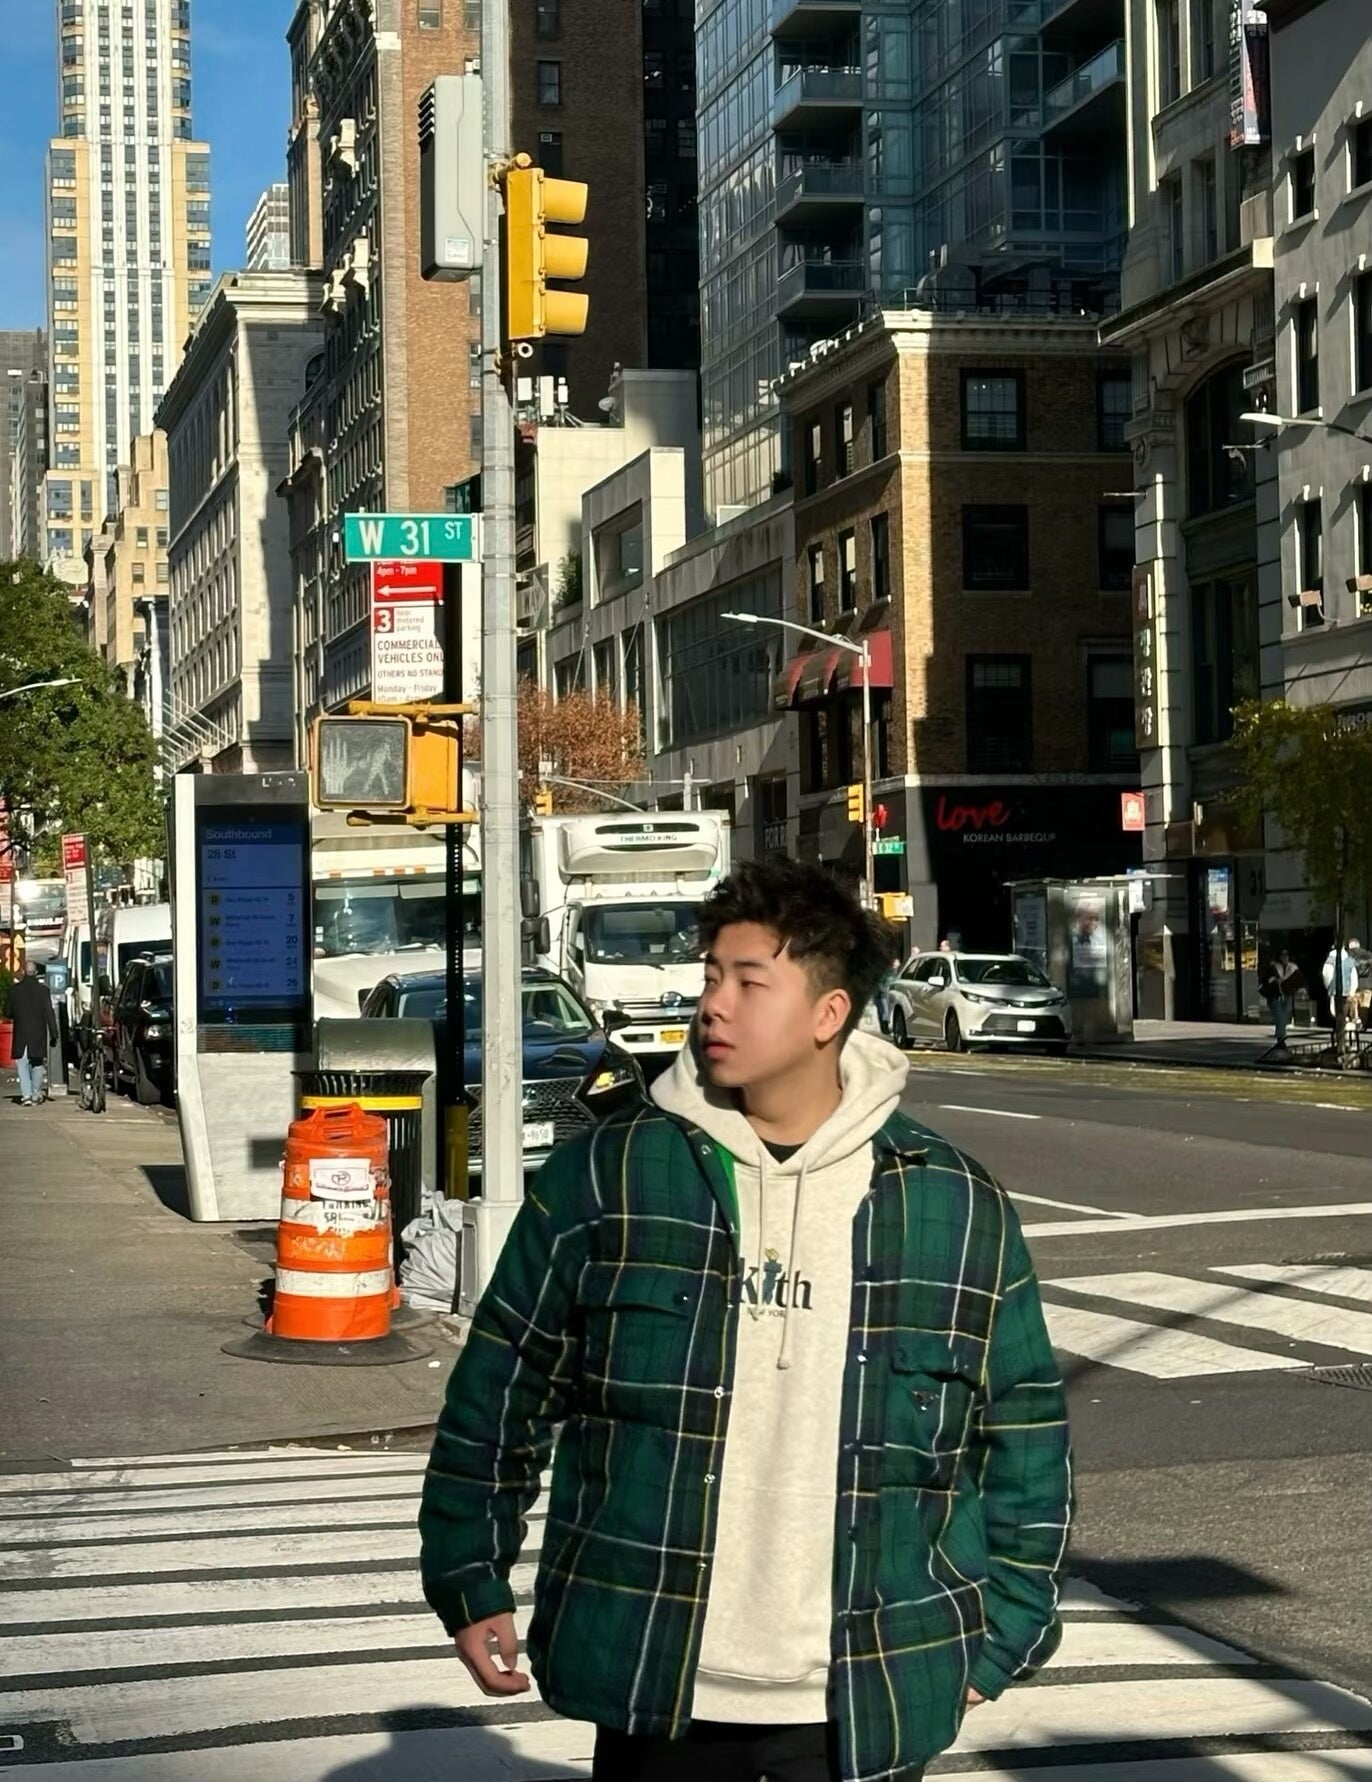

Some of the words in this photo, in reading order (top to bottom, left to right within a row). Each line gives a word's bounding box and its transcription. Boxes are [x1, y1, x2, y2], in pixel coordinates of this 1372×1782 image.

[359, 521, 385, 555] W
[400, 520, 430, 555] 31
[444, 521, 463, 539] ST
[377, 609, 392, 633] 3
[377, 639, 441, 651] COMMERCIAL
[377, 652, 423, 664] VEHICLES
[377, 669, 406, 679] OTHERS
[206, 828, 272, 839] Southbound
[620, 835, 656, 843] THERMO
[657, 833, 678, 842] KING
[963, 832, 1004, 843] KOREAN
[223, 848, 236, 859] St
[738, 1254, 813, 1310] Kith
